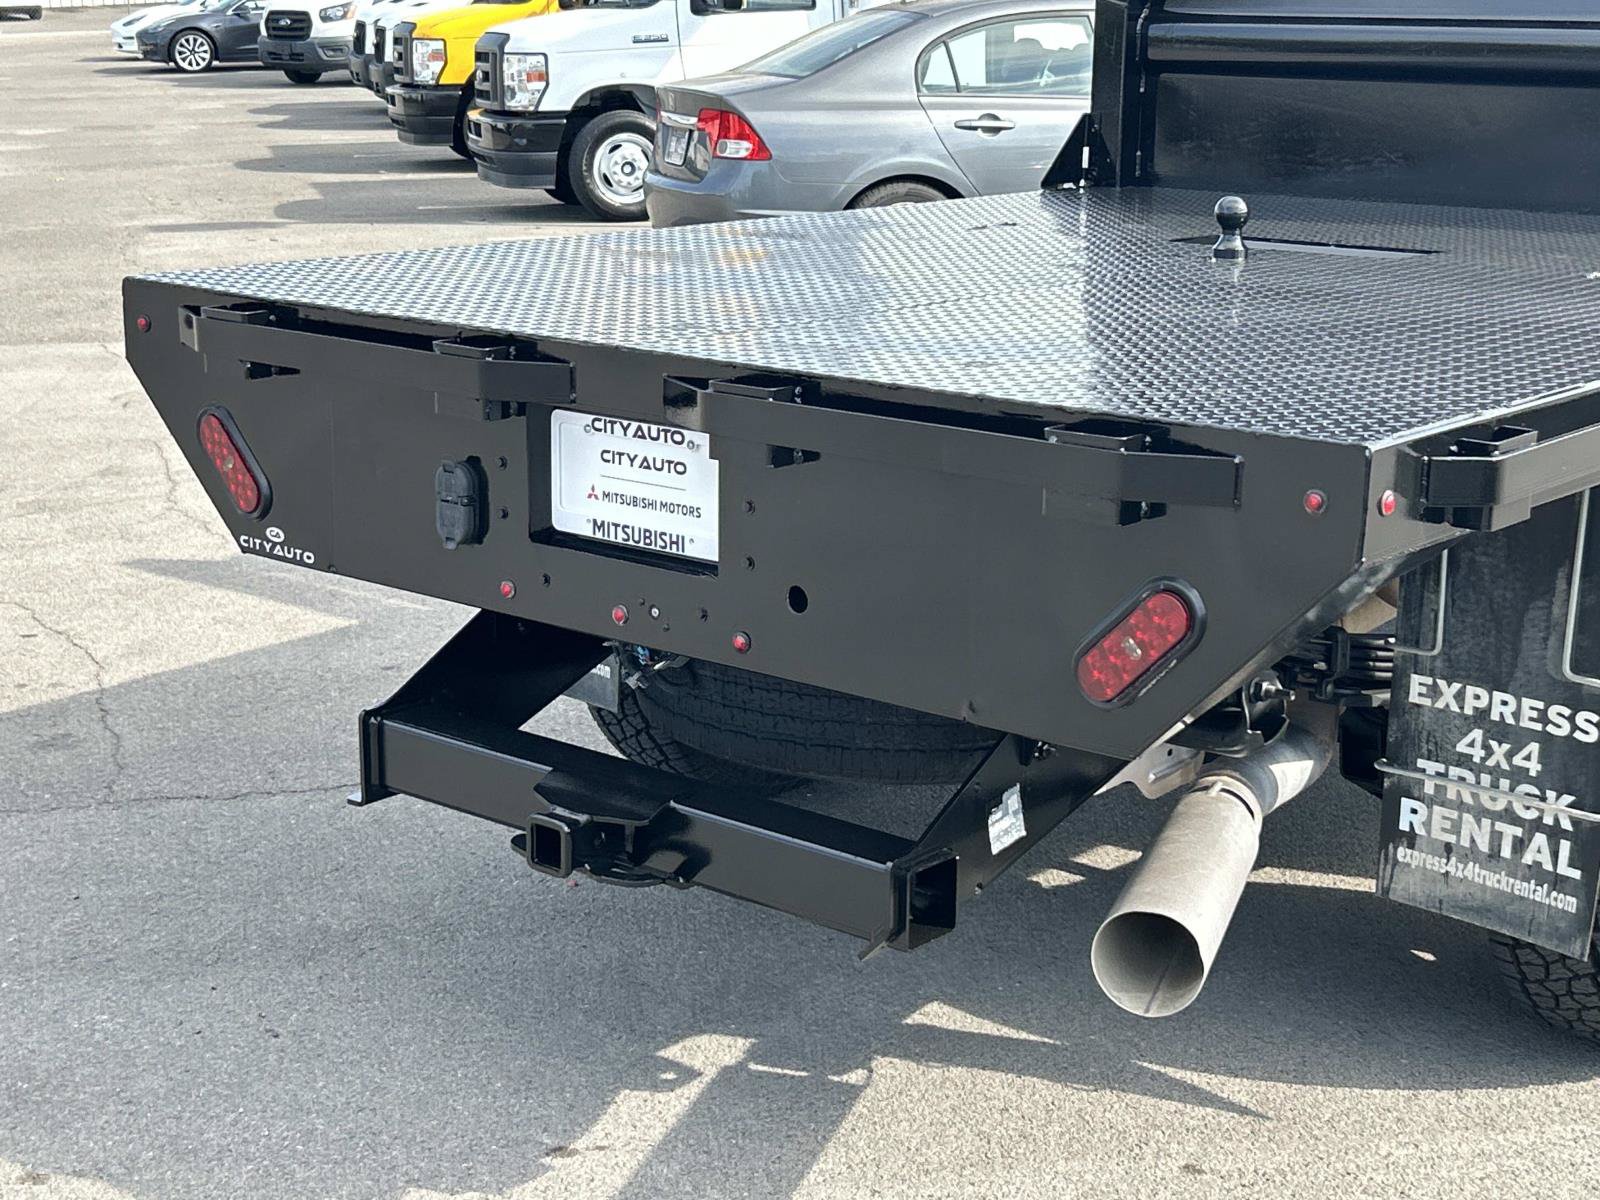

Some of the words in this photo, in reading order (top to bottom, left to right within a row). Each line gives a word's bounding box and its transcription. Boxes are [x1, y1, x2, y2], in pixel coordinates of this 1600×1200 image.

[591, 418, 685, 445] CITYAUTO
[600, 449, 687, 476] CITYAUTO
[602, 490, 658, 511] MITSUBISHI
[659, 501, 702, 519] MOTORS
[240, 535, 315, 564] CITYAUTO
[592, 518, 686, 554] MITSUBISHI
[1408, 673, 1600, 744] EXPRESS
[1455, 728, 1542, 777] 4x4
[1416, 758, 1576, 831] TRUCK
[1398, 796, 1582, 880] RENTAL
[1396, 845, 1577, 914] express4x4truckrental.com
